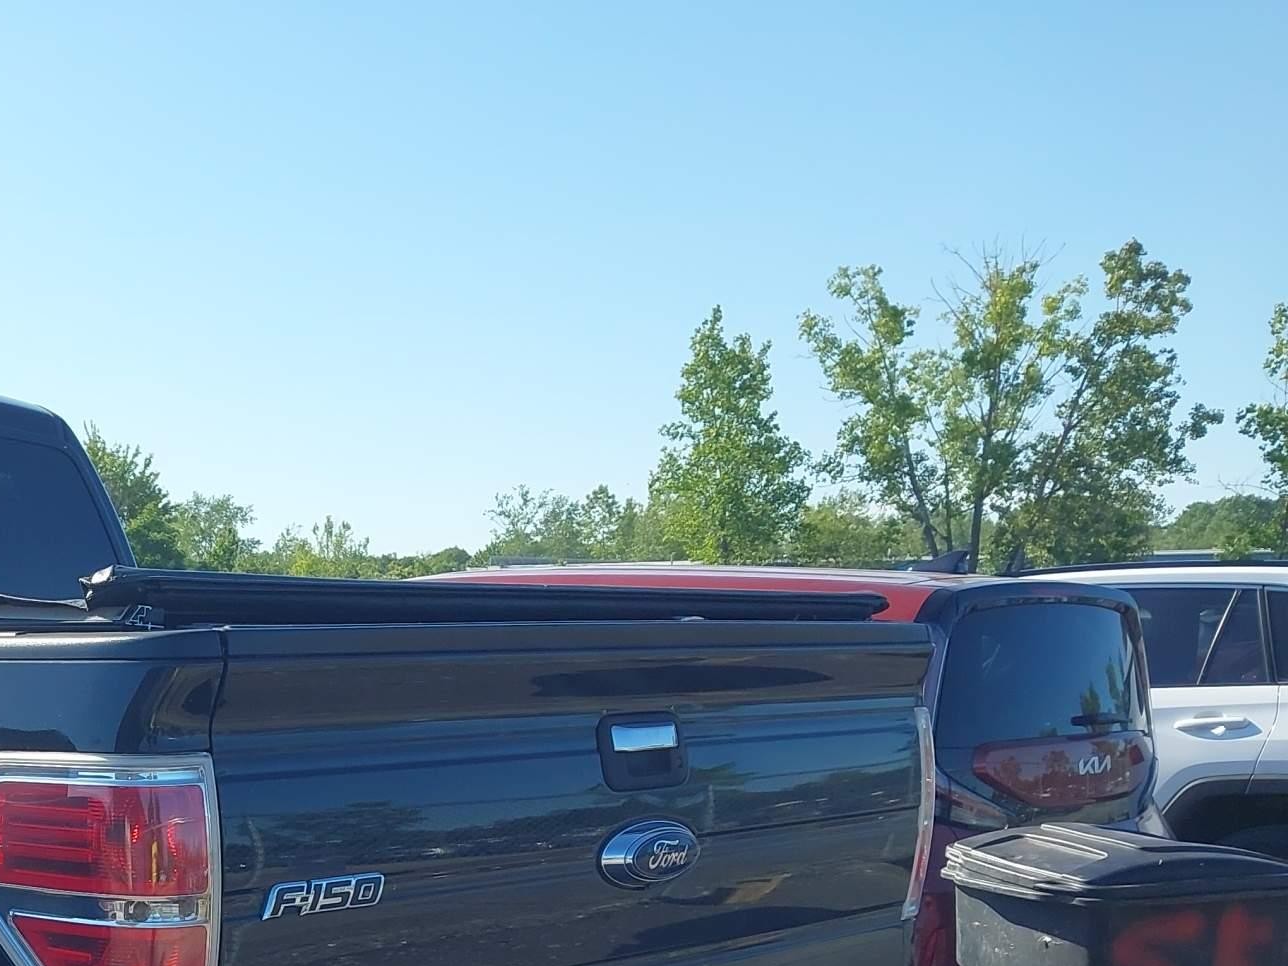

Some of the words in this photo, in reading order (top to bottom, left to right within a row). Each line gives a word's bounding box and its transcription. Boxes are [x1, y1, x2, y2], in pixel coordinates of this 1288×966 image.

[1078, 754, 1112, 775] KIA
[649, 840, 688, 870] Ford
[261, 873, 384, 921] F-150
